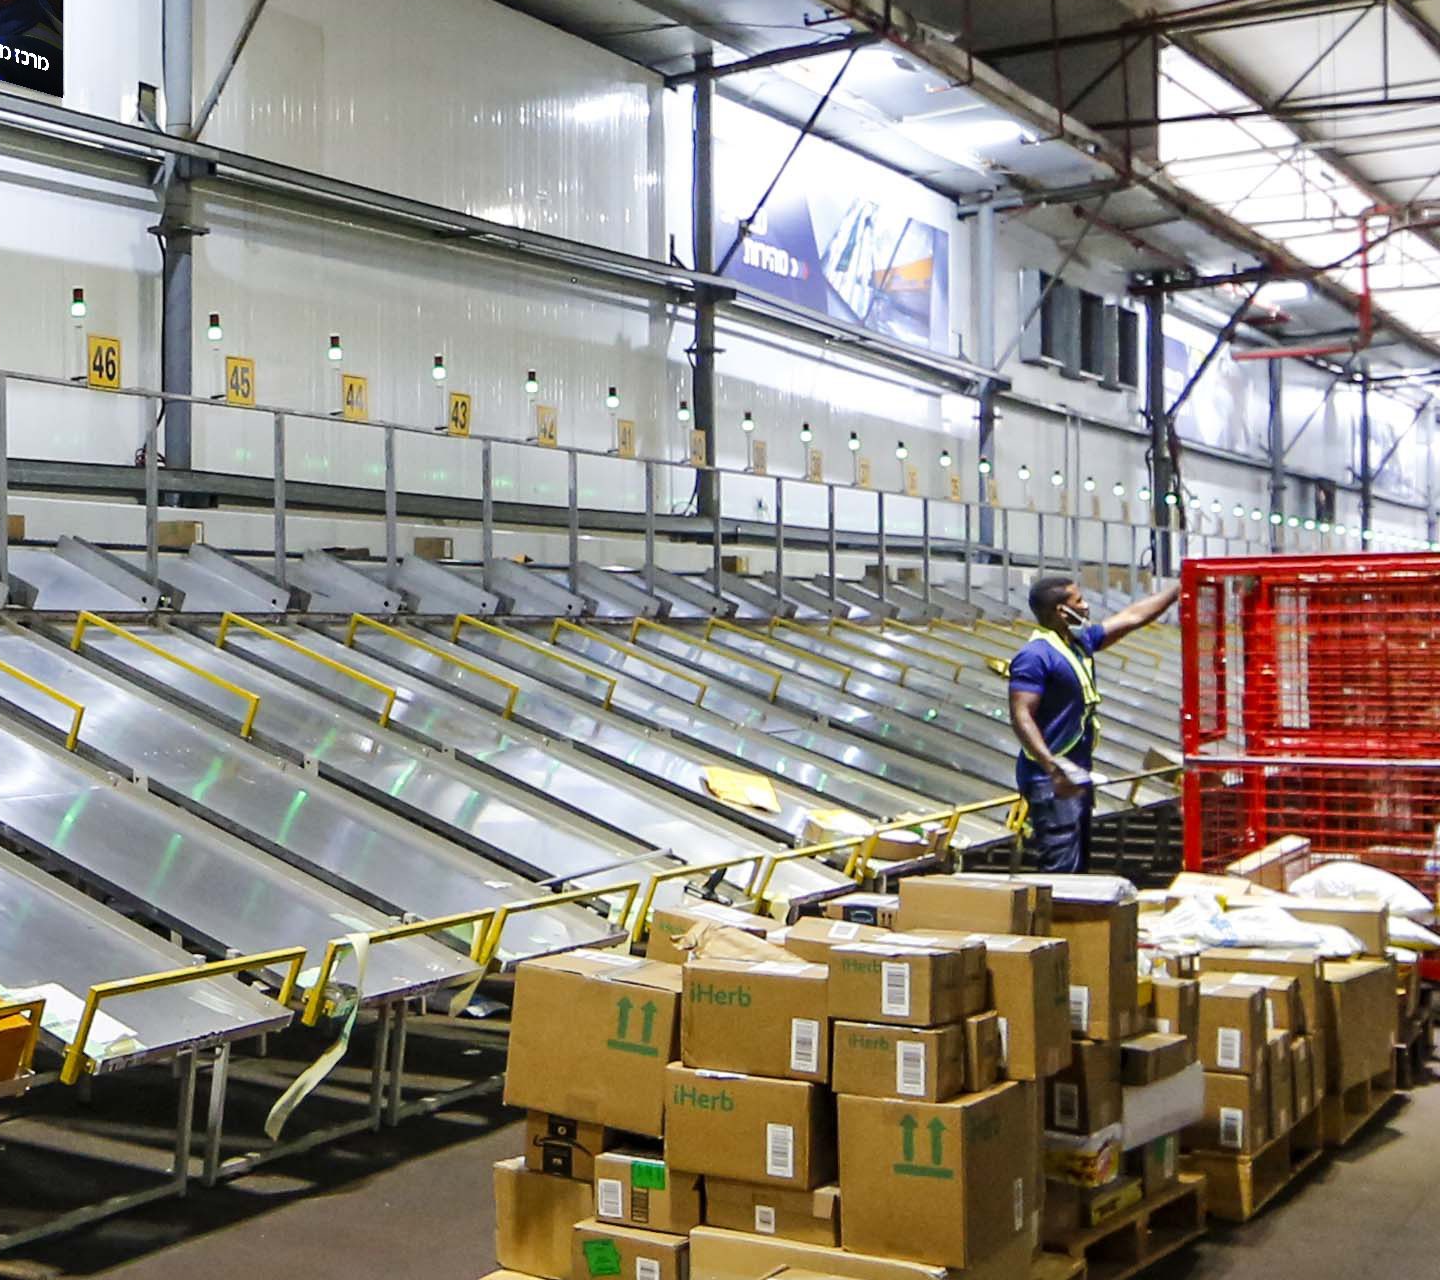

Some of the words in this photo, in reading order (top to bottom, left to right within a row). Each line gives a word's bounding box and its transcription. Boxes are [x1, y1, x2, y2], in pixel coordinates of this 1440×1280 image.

[14, 48, 50, 72] מרכז
[92, 344, 117, 381] 46
[229, 366, 251, 398] 45
[346, 383, 367, 411] 44
[451, 401, 468, 429] 43
[690, 983, 752, 1008] iHerb
[848, 1035, 889, 1051] iHerb
[673, 1084, 735, 1112] iHerb
